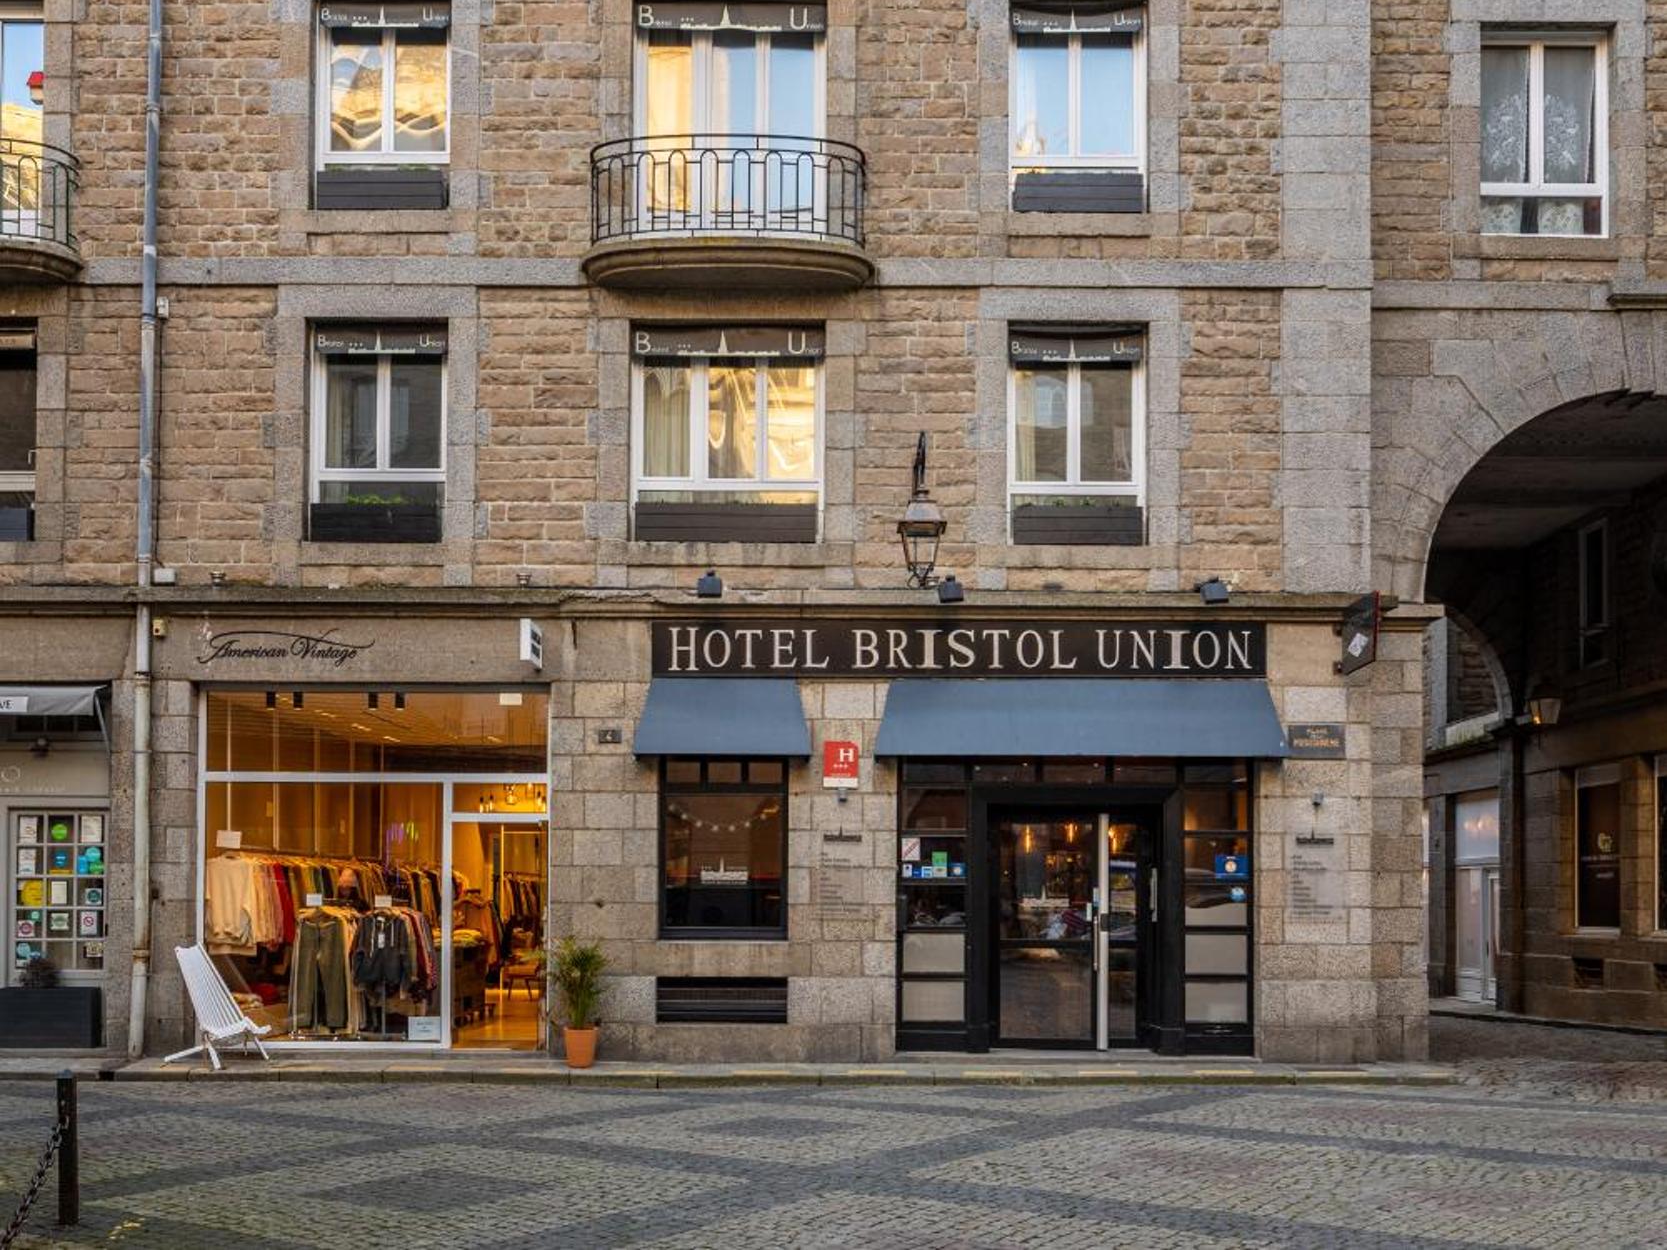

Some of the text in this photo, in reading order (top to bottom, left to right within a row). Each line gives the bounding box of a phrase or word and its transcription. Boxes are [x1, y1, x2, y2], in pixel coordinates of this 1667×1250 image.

[197, 628, 359, 667] American Vintage
[668, 626, 1253, 671] HOTEL BRISTOL UNION
[839, 748, 855, 762] H
